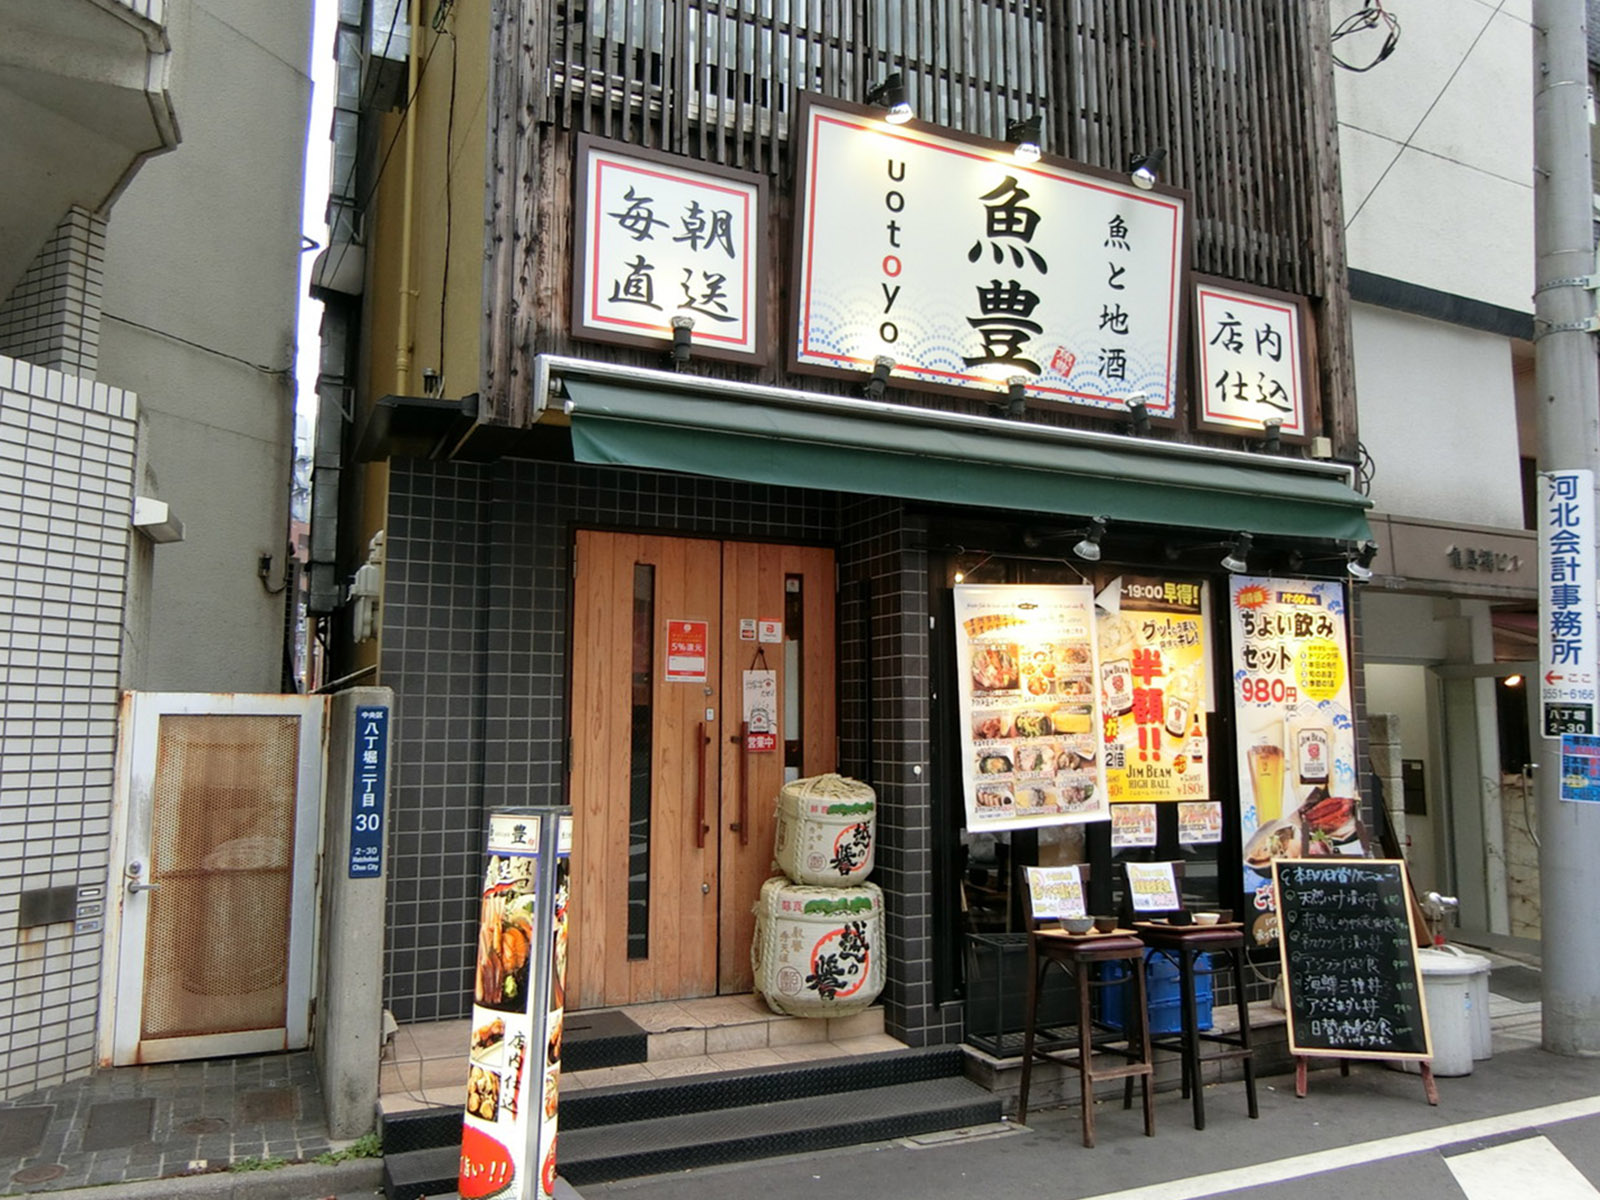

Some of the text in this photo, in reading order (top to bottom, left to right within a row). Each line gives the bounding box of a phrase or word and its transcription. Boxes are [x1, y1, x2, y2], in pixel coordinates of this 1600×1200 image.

[606, 185, 738, 260] 毎朝
[880, 157, 907, 345] uotoyo
[964, 174, 1049, 377] 魚豊
[607, 252, 741, 323] 直送
[1098, 212, 1133, 383] 魚と地酒
[1209, 311, 1285, 365] 店内
[1215, 369, 1293, 415] 仕込
[1548, 474, 1583, 666] 河北会計事務所
[1241, 610, 1334, 638] ちょい飲み
[1243, 645, 1292, 670] セット
[361, 711, 384, 719] 中央区
[1241, 677, 1298, 703] 980円
[1550, 722, 1586, 734] 2-30
[362, 722, 380, 807] 八丁堀二丁目
[1126, 764, 1146, 778] JIM
[1146, 764, 1172, 778] BEAM
[355, 813, 380, 832] 30
[354, 847, 378, 855] 2-30
[499, 1030, 526, 1116] 店内仕込
